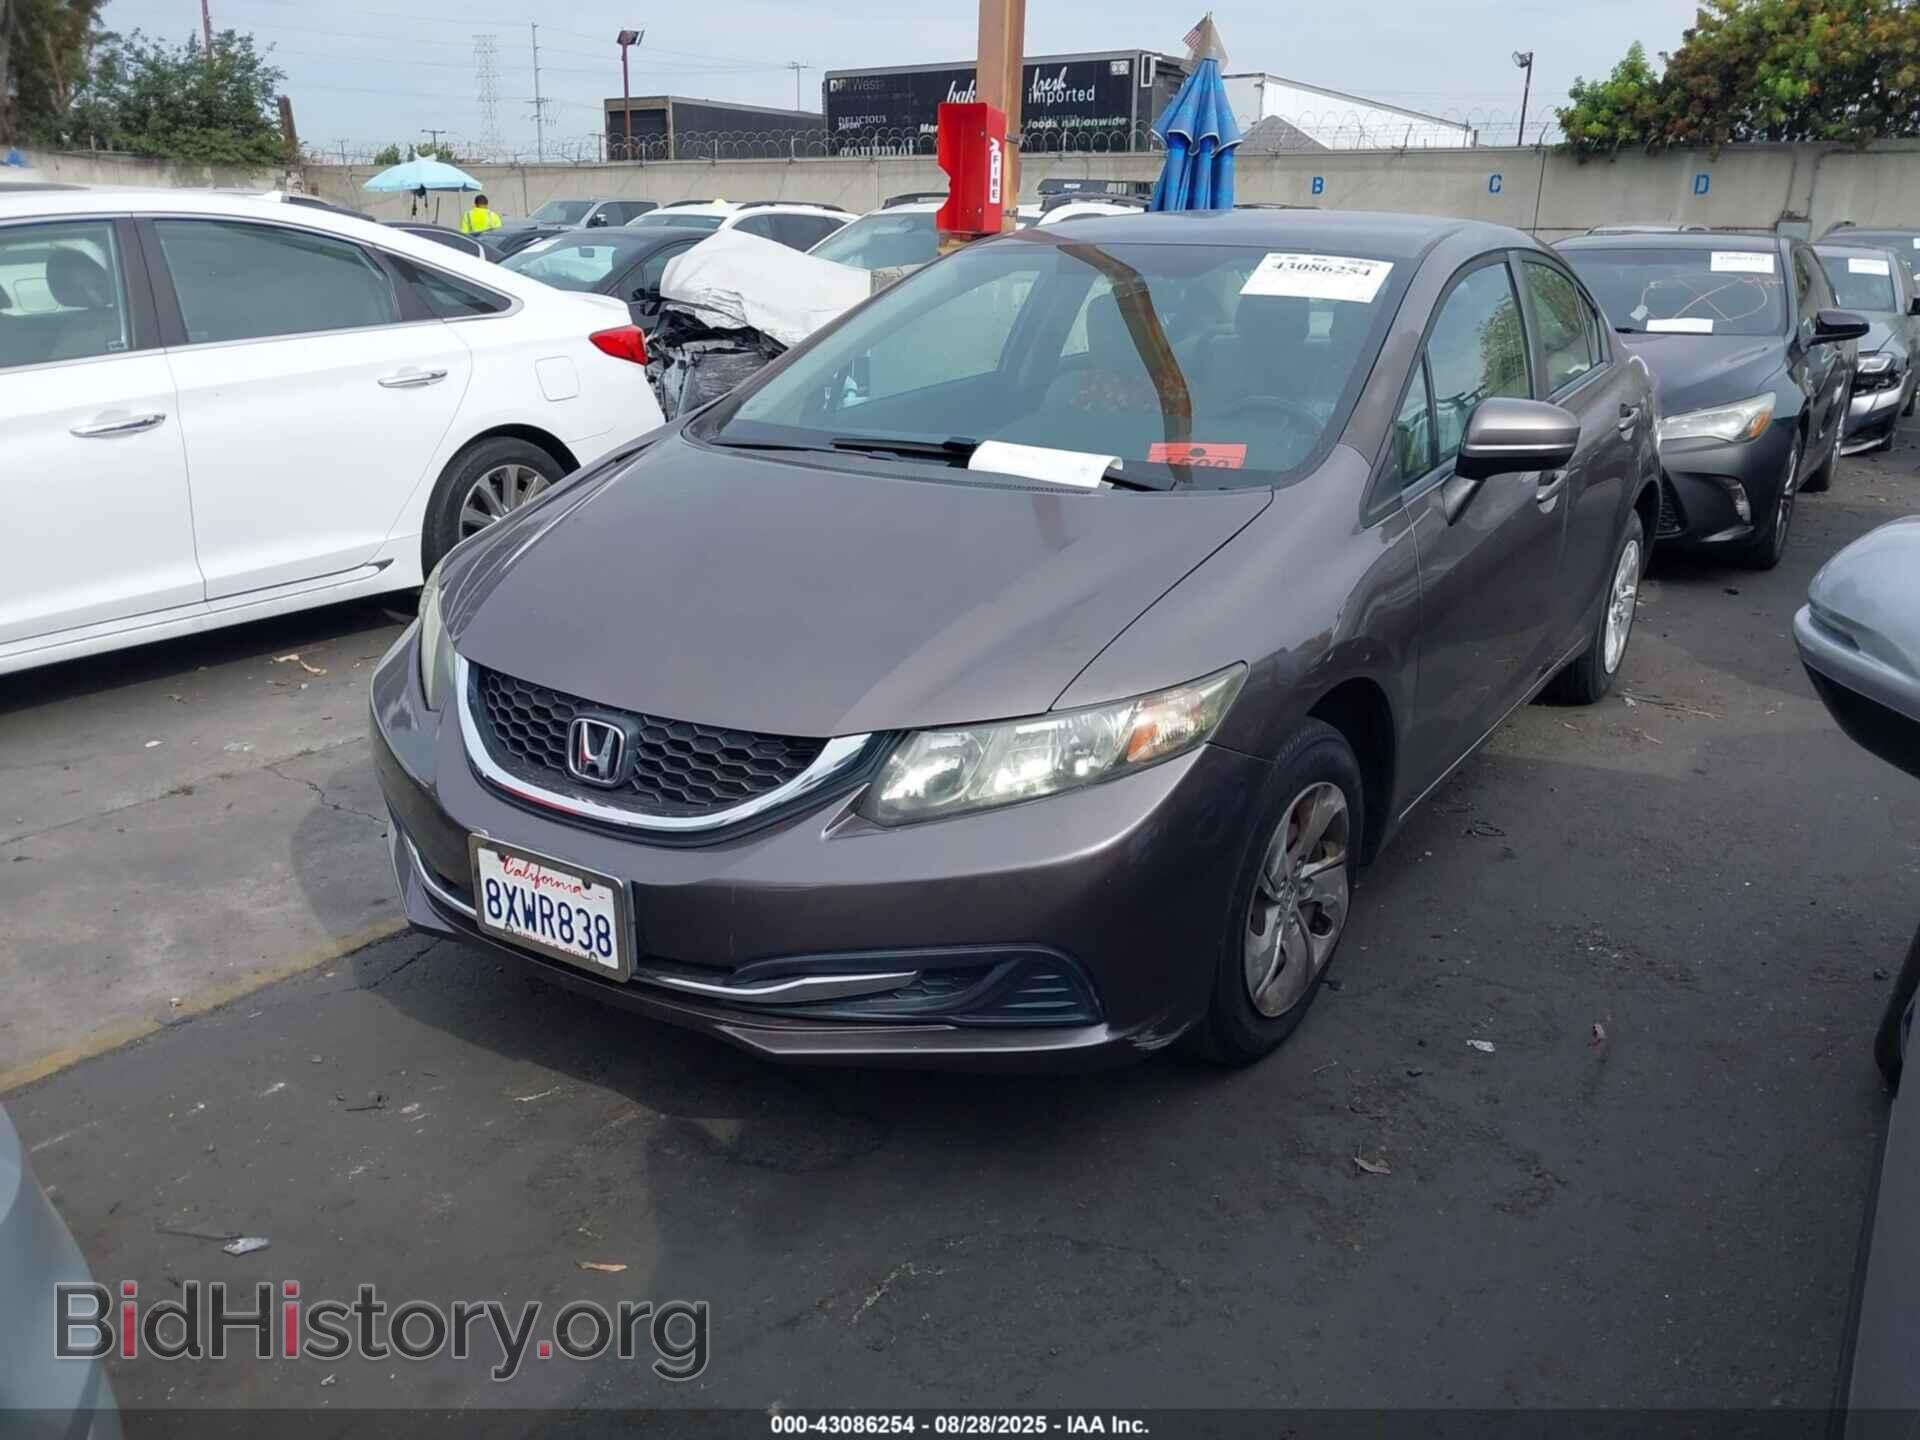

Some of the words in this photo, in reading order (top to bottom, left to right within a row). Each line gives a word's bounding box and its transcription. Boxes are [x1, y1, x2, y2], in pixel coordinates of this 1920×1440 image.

[1028, 85, 1096, 105] imported
[1027, 118, 1058, 129] foods
[1061, 115, 1127, 128] nationwide
[991, 154, 1000, 200] FIRE
[1311, 176, 1325, 194] B
[1488, 174, 1502, 193] C
[1693, 174, 1710, 195] D
[502, 855, 592, 900] California
[485, 878, 613, 958] 8XWR838
